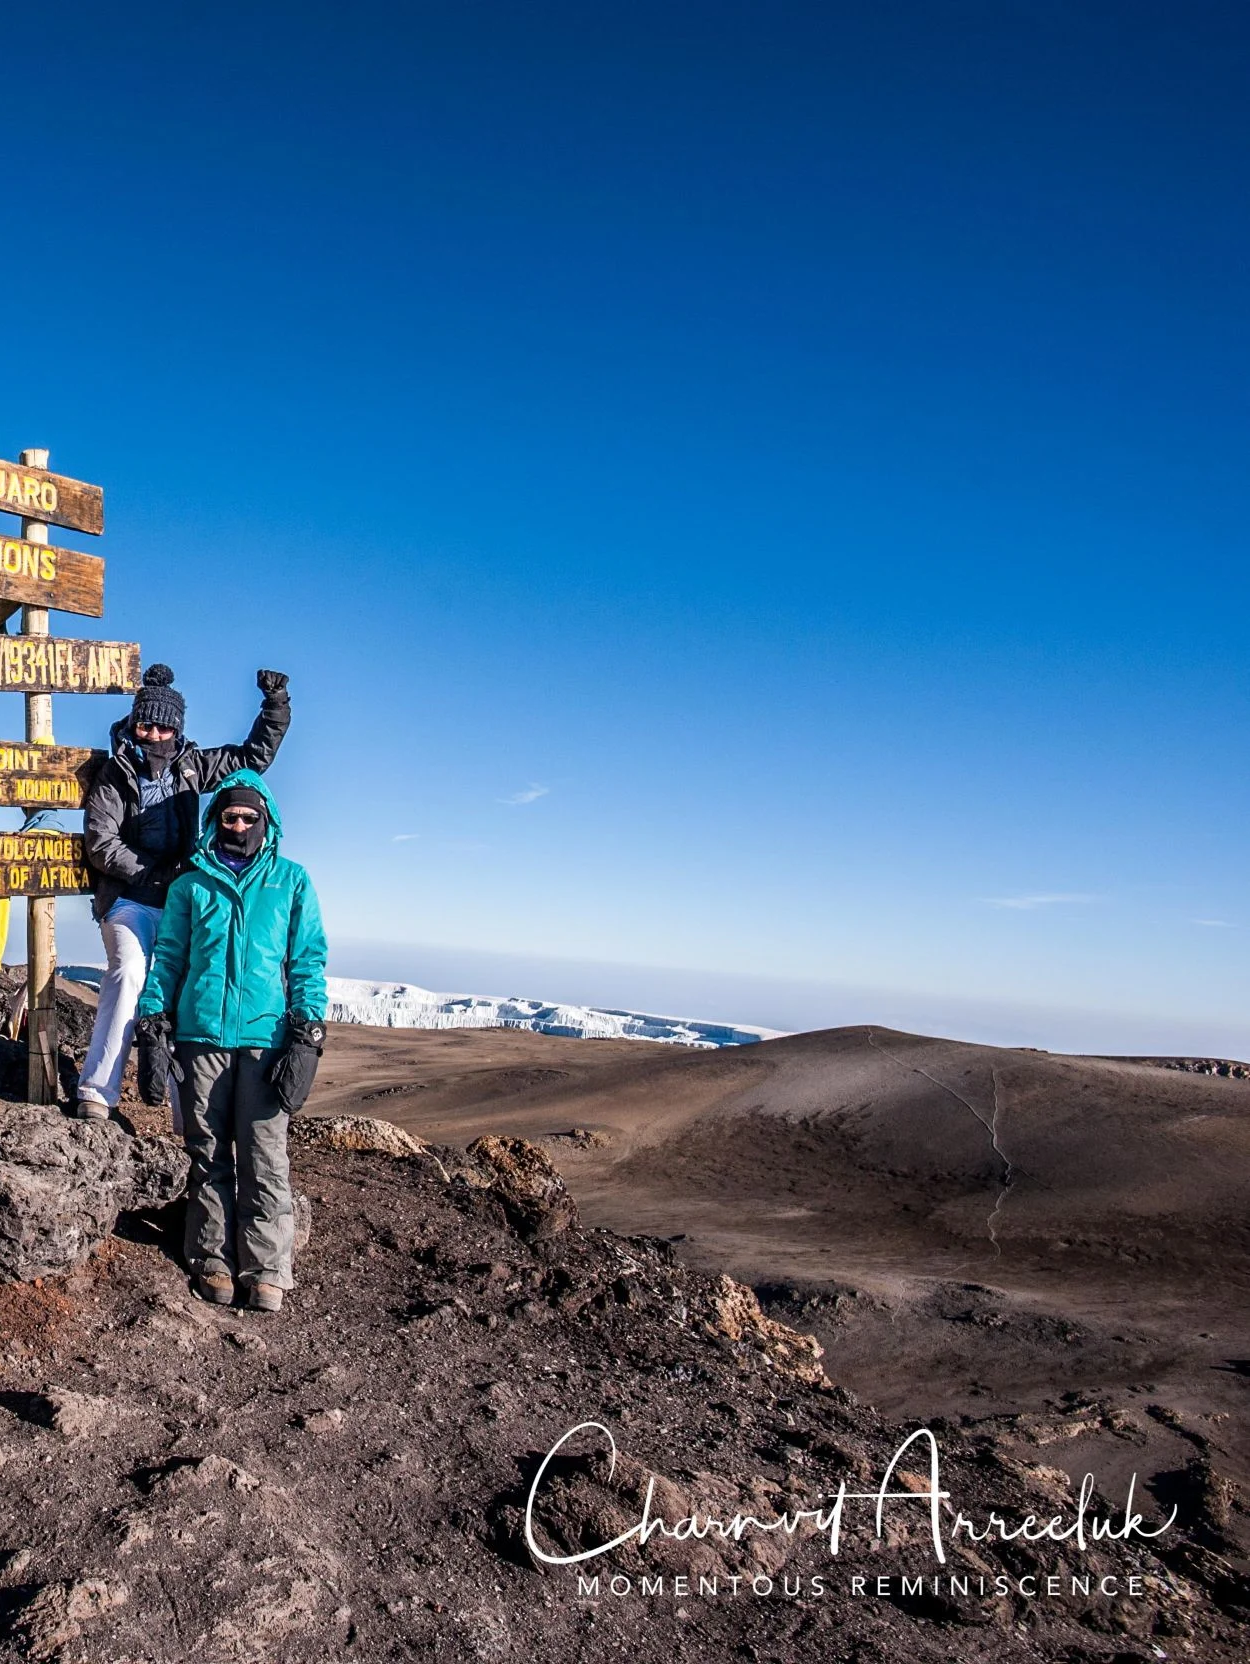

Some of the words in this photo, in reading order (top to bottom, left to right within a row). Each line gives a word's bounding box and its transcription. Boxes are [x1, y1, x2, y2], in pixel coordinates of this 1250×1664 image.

[16, 778, 79, 801] MOUNTAIN
[10, 865, 31, 890] OF
[41, 866, 90, 889] AFRICA
